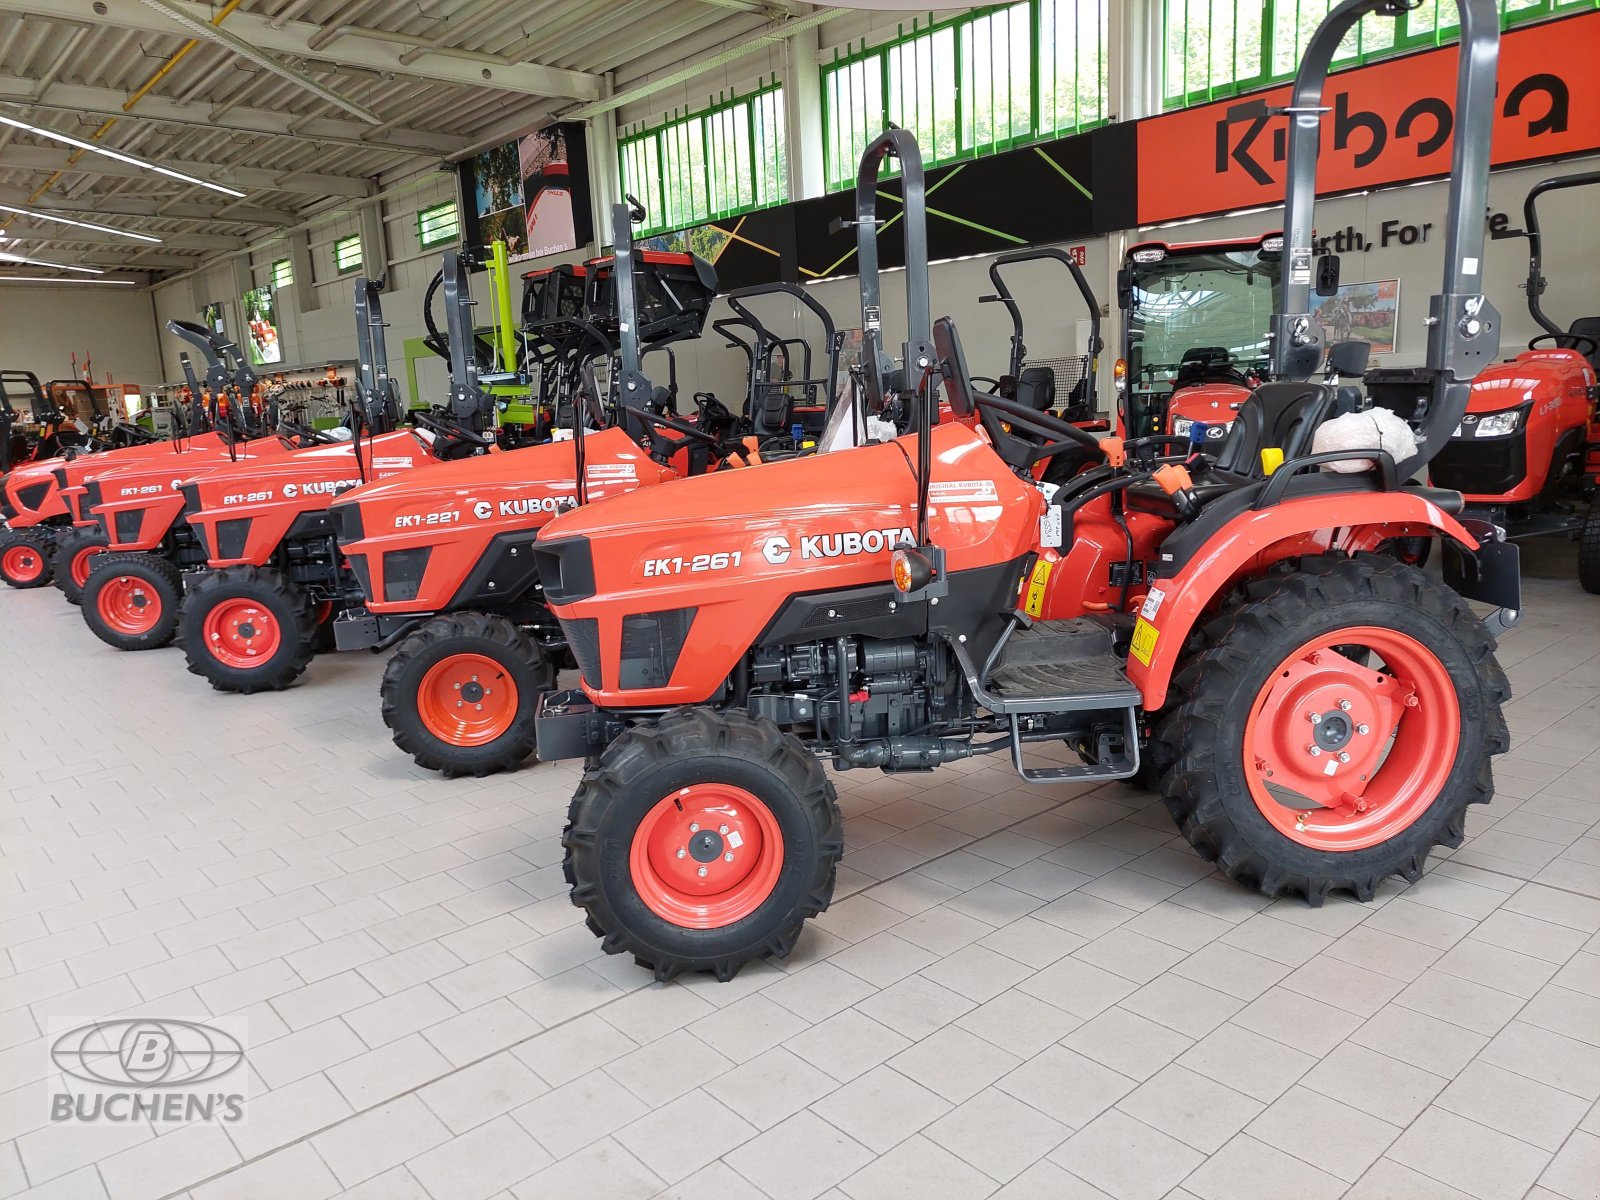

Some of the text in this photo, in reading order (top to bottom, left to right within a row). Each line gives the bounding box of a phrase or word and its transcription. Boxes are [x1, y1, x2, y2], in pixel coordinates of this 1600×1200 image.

[1381, 219, 1432, 248] For
[121, 484, 163, 496] EK1-261
[223, 490, 273, 505] EK1-261
[394, 510, 460, 528] EK1-221
[643, 527, 918, 577] EK1-261 KUBOTA
